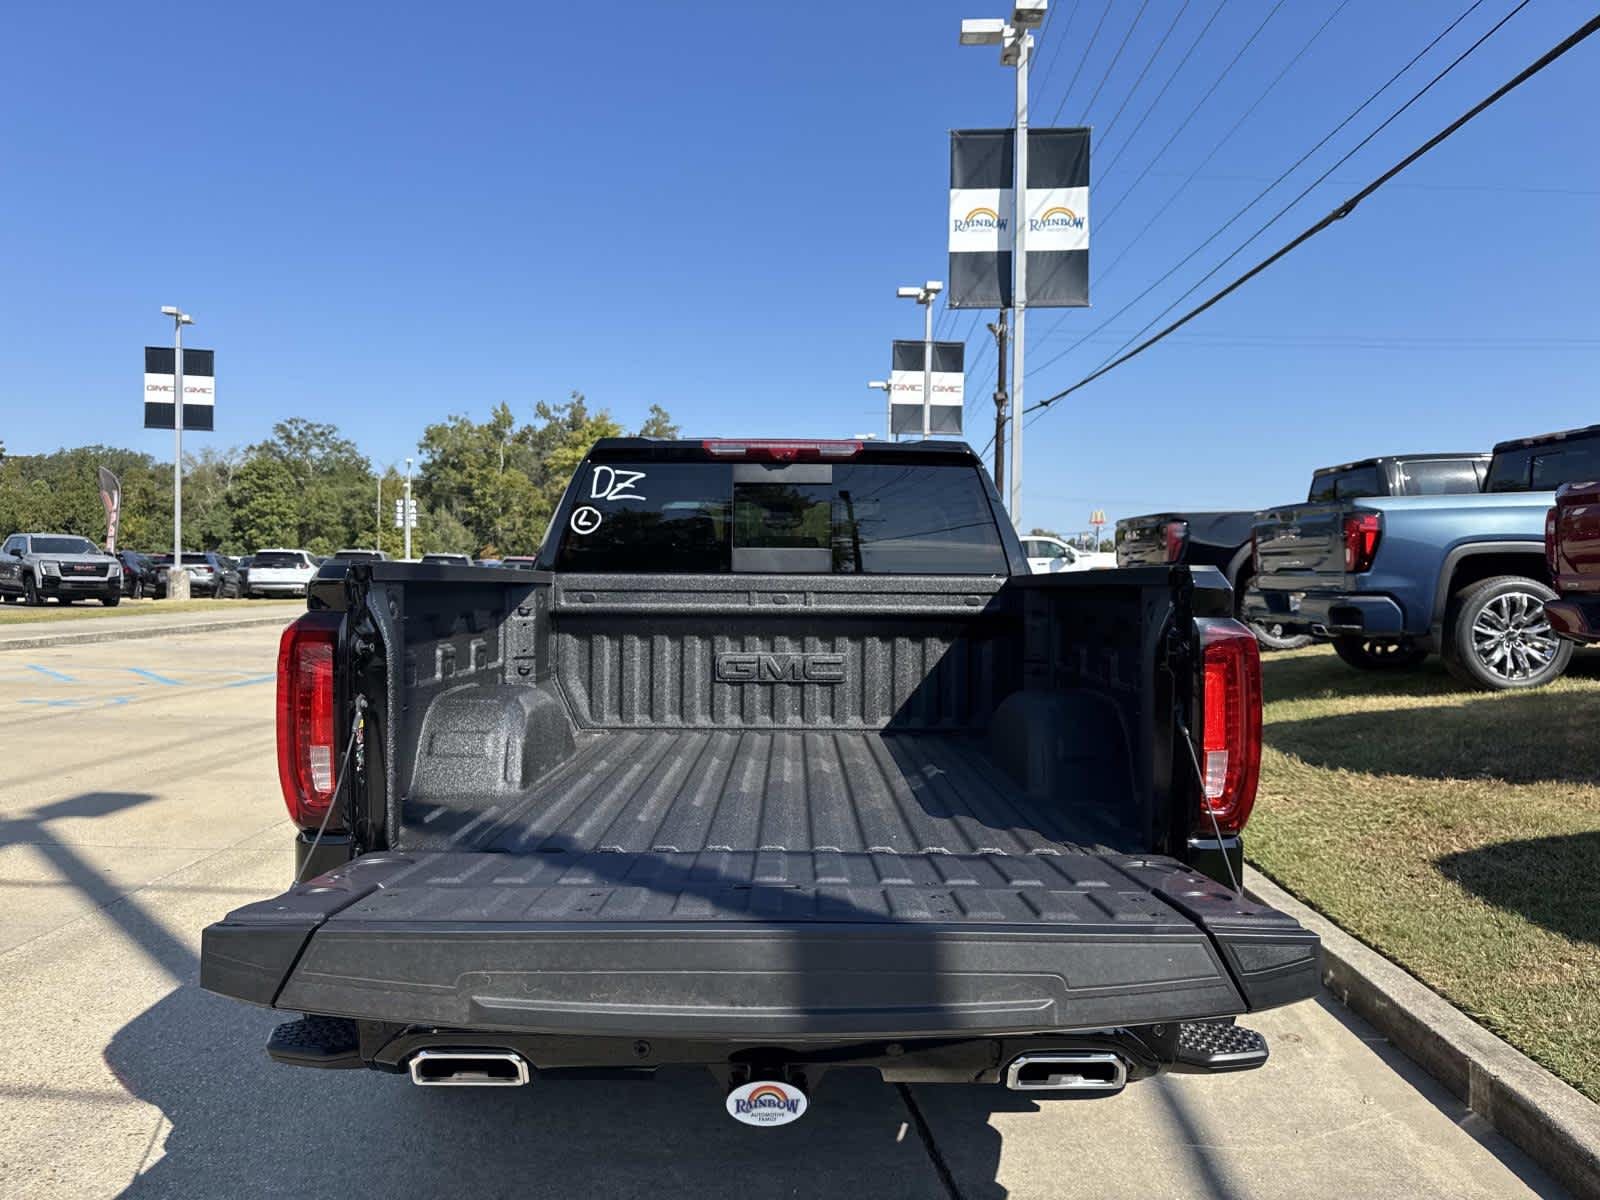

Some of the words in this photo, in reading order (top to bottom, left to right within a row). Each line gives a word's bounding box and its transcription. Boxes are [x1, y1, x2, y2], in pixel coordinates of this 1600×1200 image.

[953, 218, 1008, 232] RAINBOW
[1029, 217, 1085, 232] RAINBOW
[717, 653, 846, 682] GMC
[735, 1099, 800, 1114] RAINBOW
